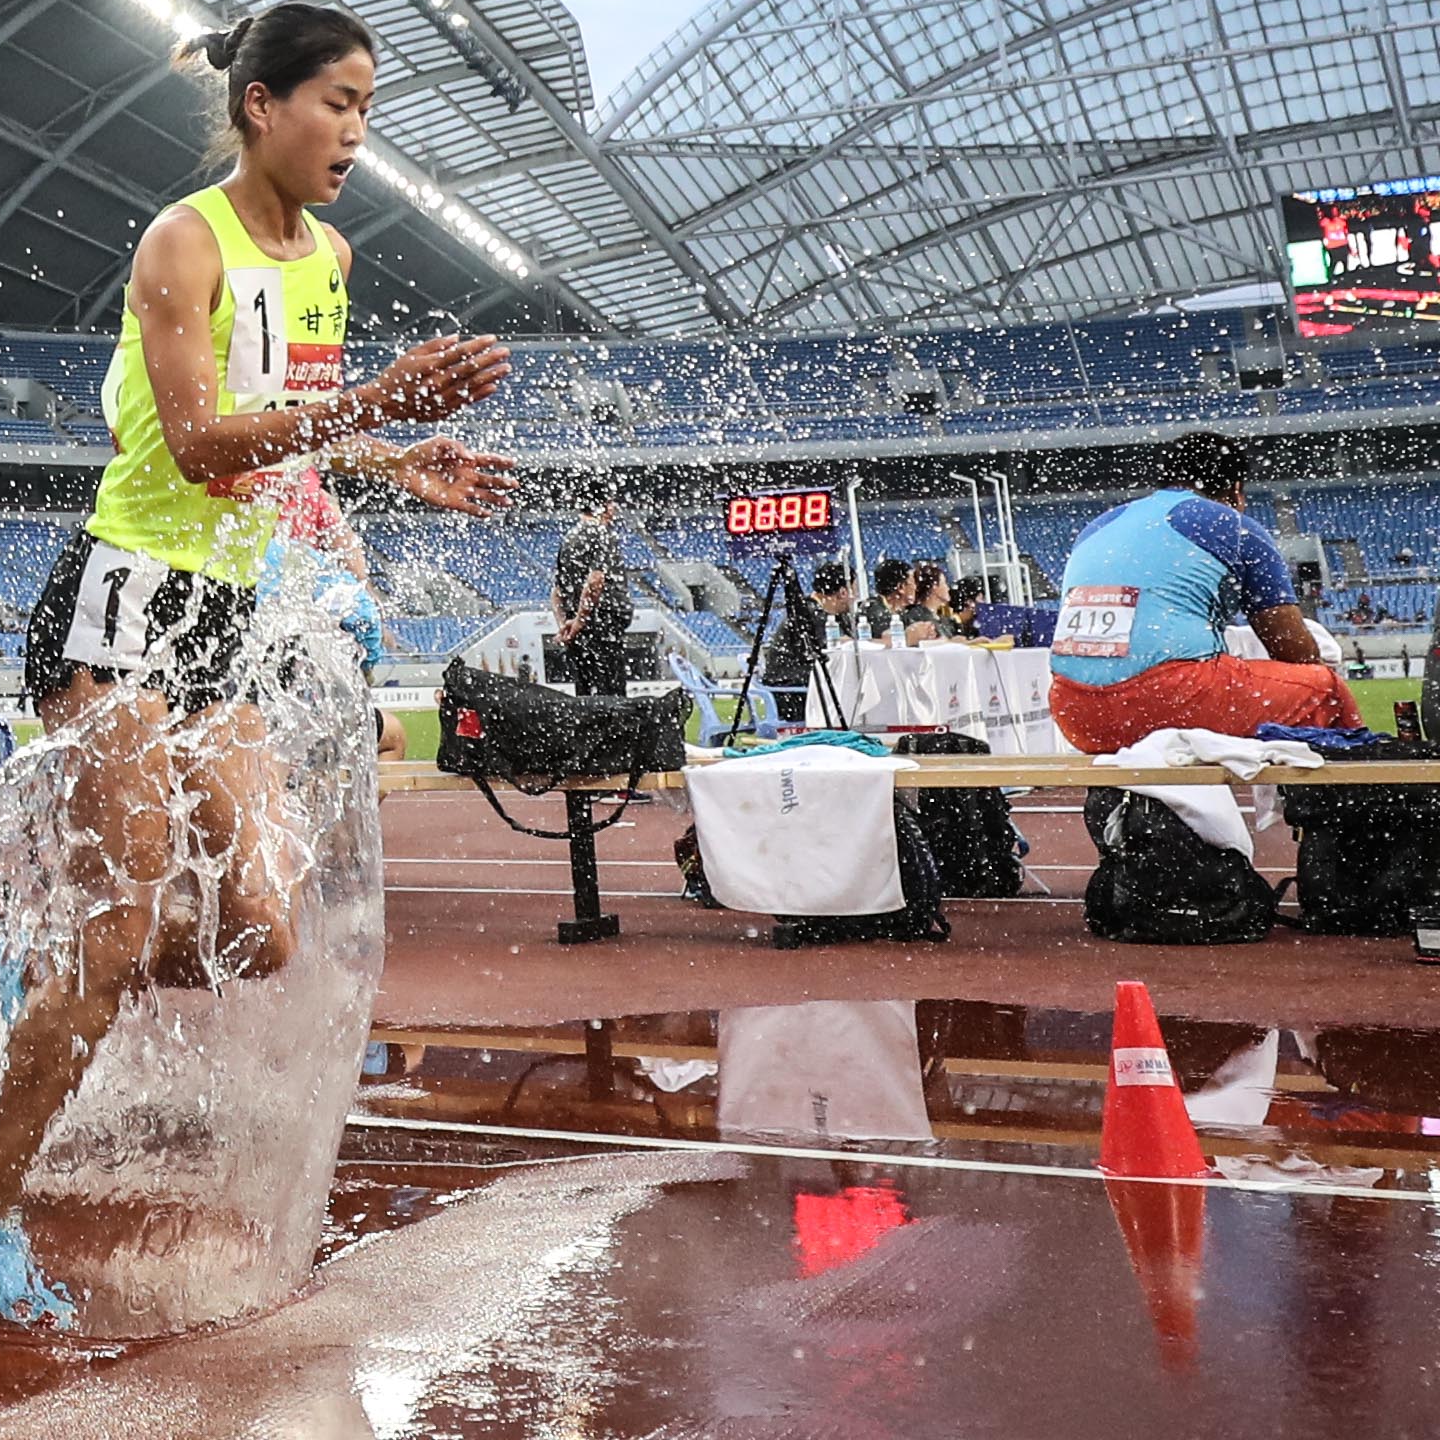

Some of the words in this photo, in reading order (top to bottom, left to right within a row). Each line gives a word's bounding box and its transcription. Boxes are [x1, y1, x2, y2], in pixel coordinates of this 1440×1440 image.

[254, 288, 270, 375] 1
[729, 493, 828, 533] 8888
[102, 567, 132, 648] 1
[1067, 611, 1116, 635] 419
